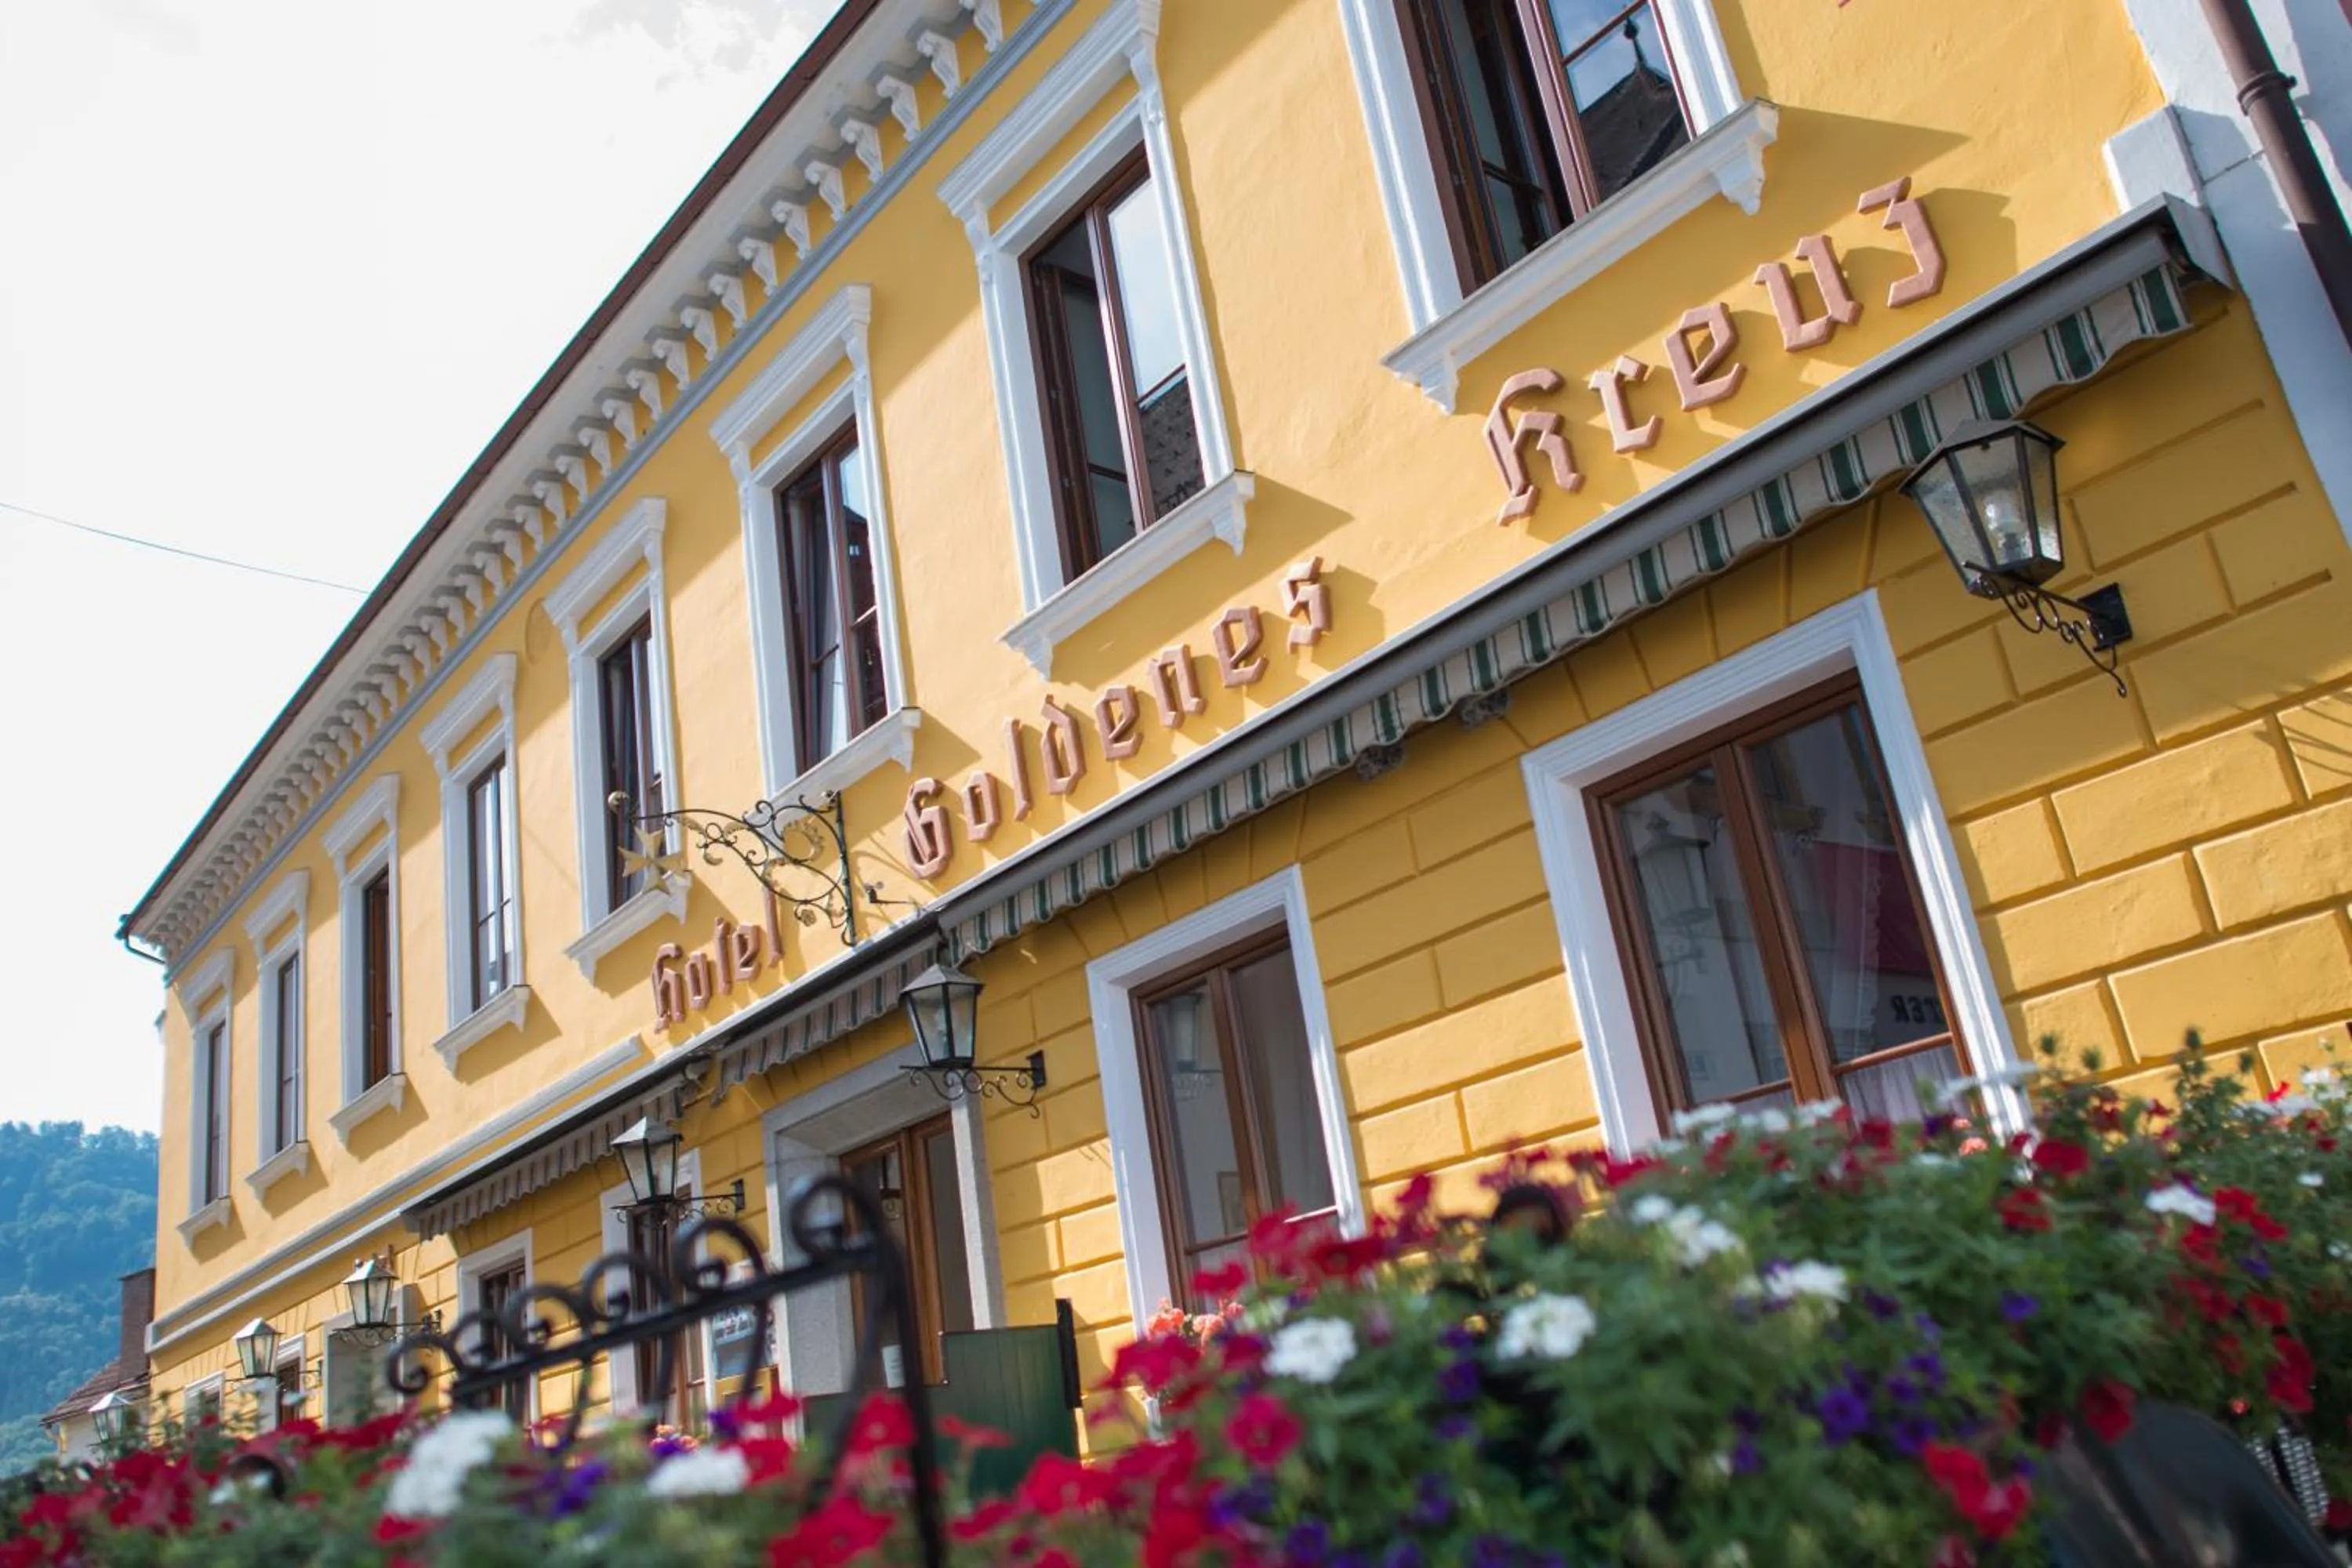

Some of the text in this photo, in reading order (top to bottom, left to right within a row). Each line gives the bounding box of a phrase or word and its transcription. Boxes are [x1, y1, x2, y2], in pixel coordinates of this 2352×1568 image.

[652, 176, 1947, 1034] Hotel Goldenes Kreuz
